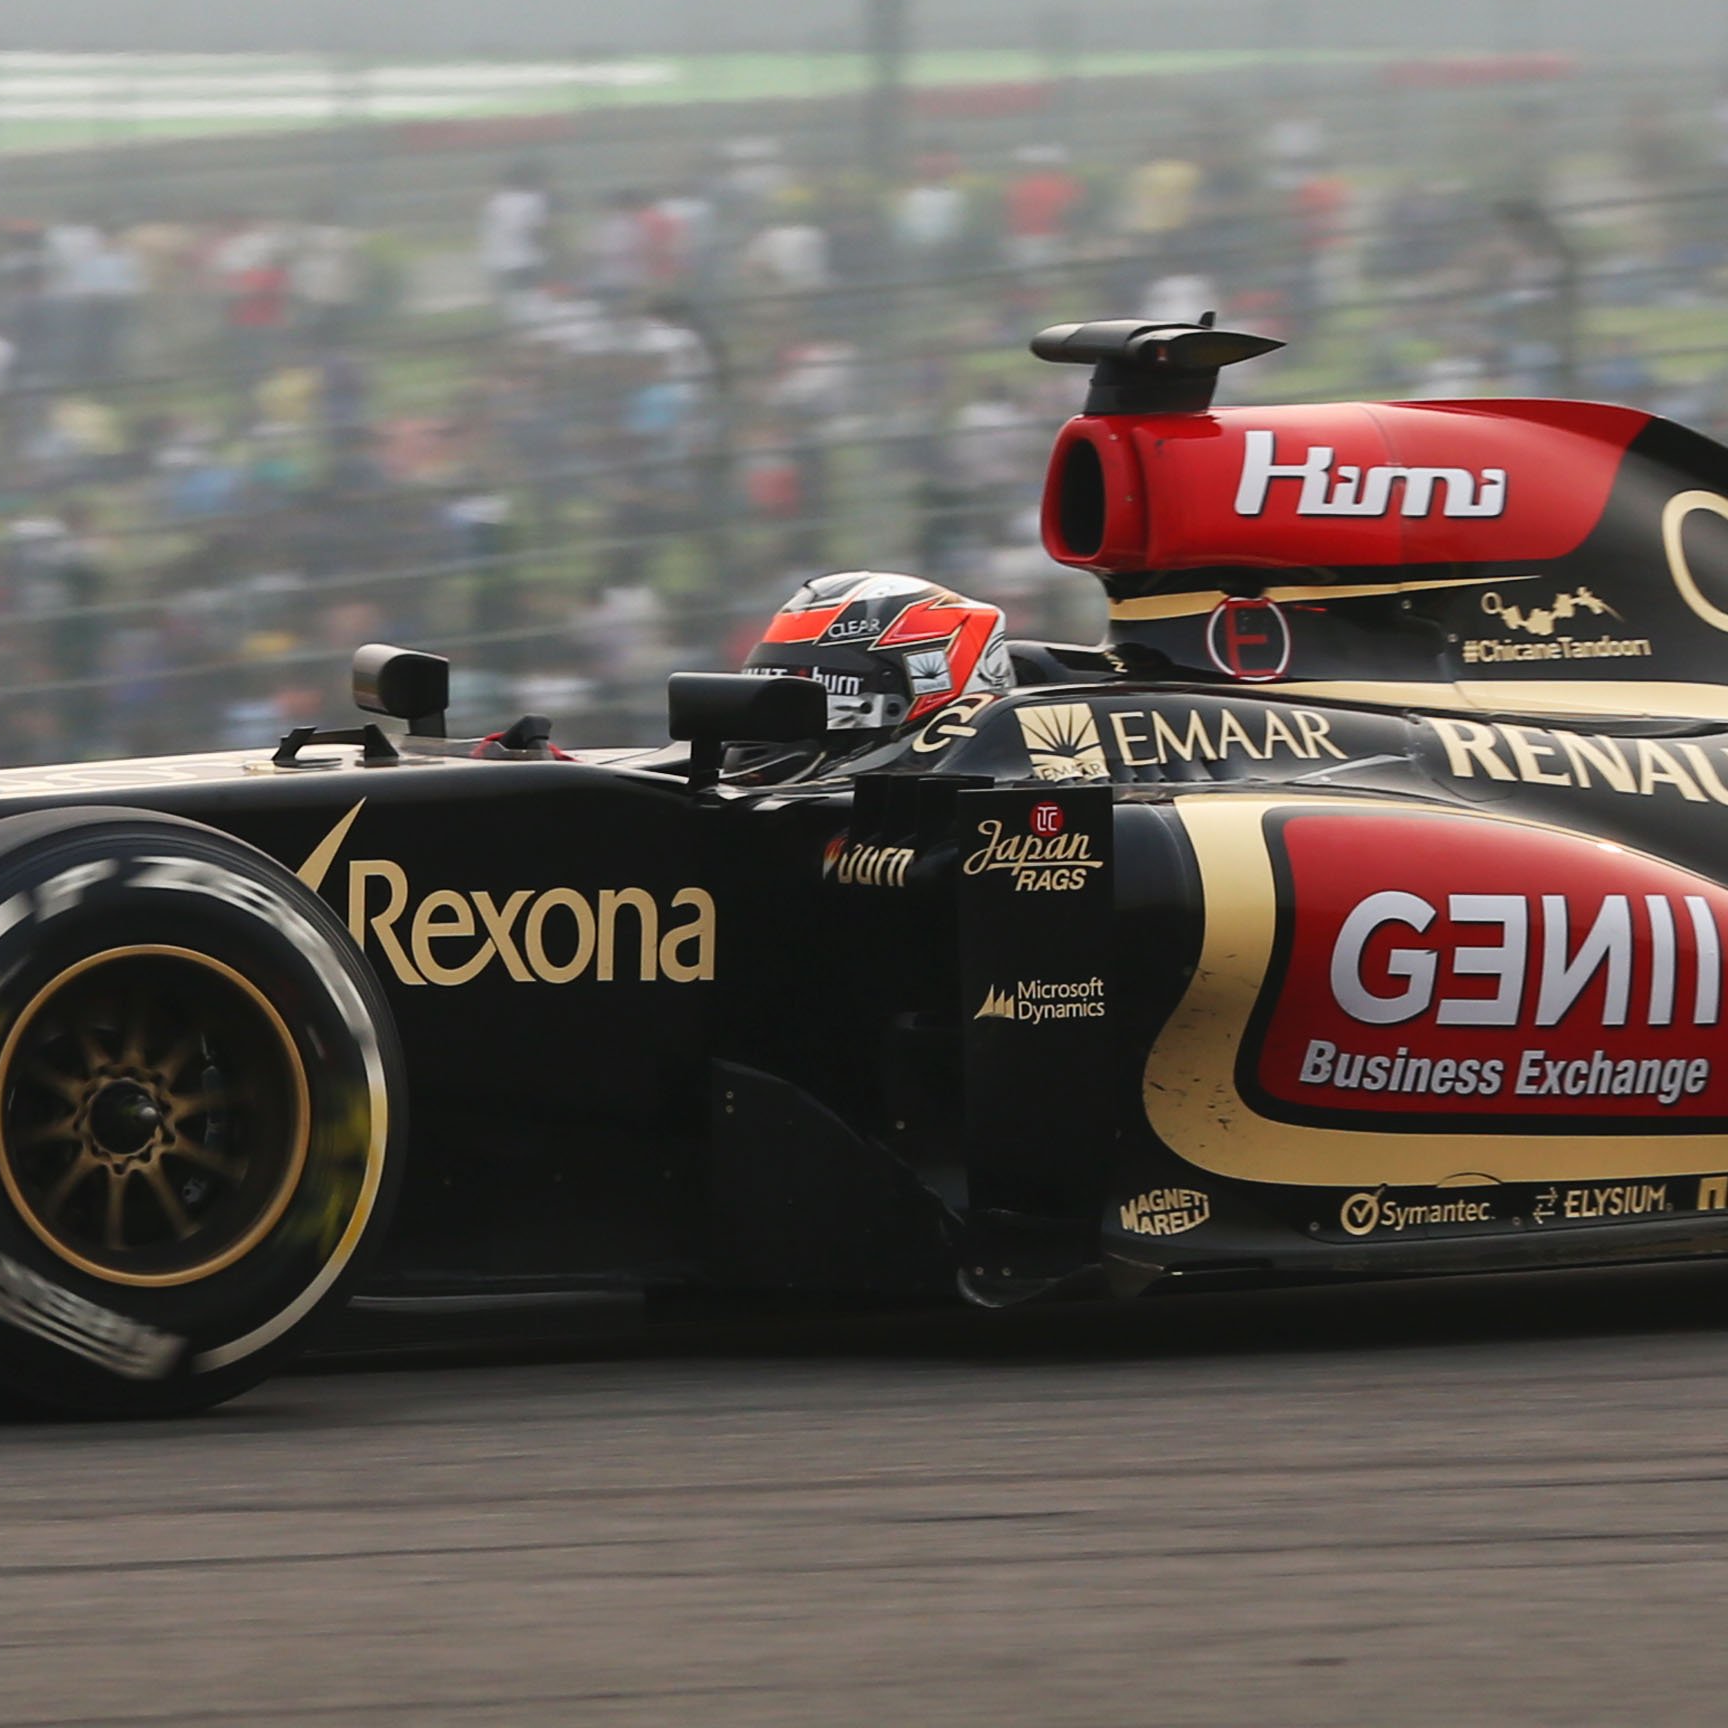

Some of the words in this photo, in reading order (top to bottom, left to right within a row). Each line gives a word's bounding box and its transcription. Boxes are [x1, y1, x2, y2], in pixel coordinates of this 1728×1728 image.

[827, 613, 881, 639] CLEAR
[1108, 708, 1350, 767] EMAAR
[962, 818, 1096, 877] Japan
[1014, 868, 1088, 892] RAGS
[348, 859, 717, 987] Rexona
[1017, 976, 1105, 1000] Microsoft
[1017, 997, 1106, 1025] Dynamics
[1298, 1039, 1504, 1094] Business
[1514, 1049, 1710, 1104] Exchange
[1119, 1187, 1209, 1218] MAGNETI
[1121, 1200, 1211, 1236] MARELLI
[1380, 1198, 1491, 1232] Symantec
[1563, 1184, 1667, 1219] ELYSIUM
